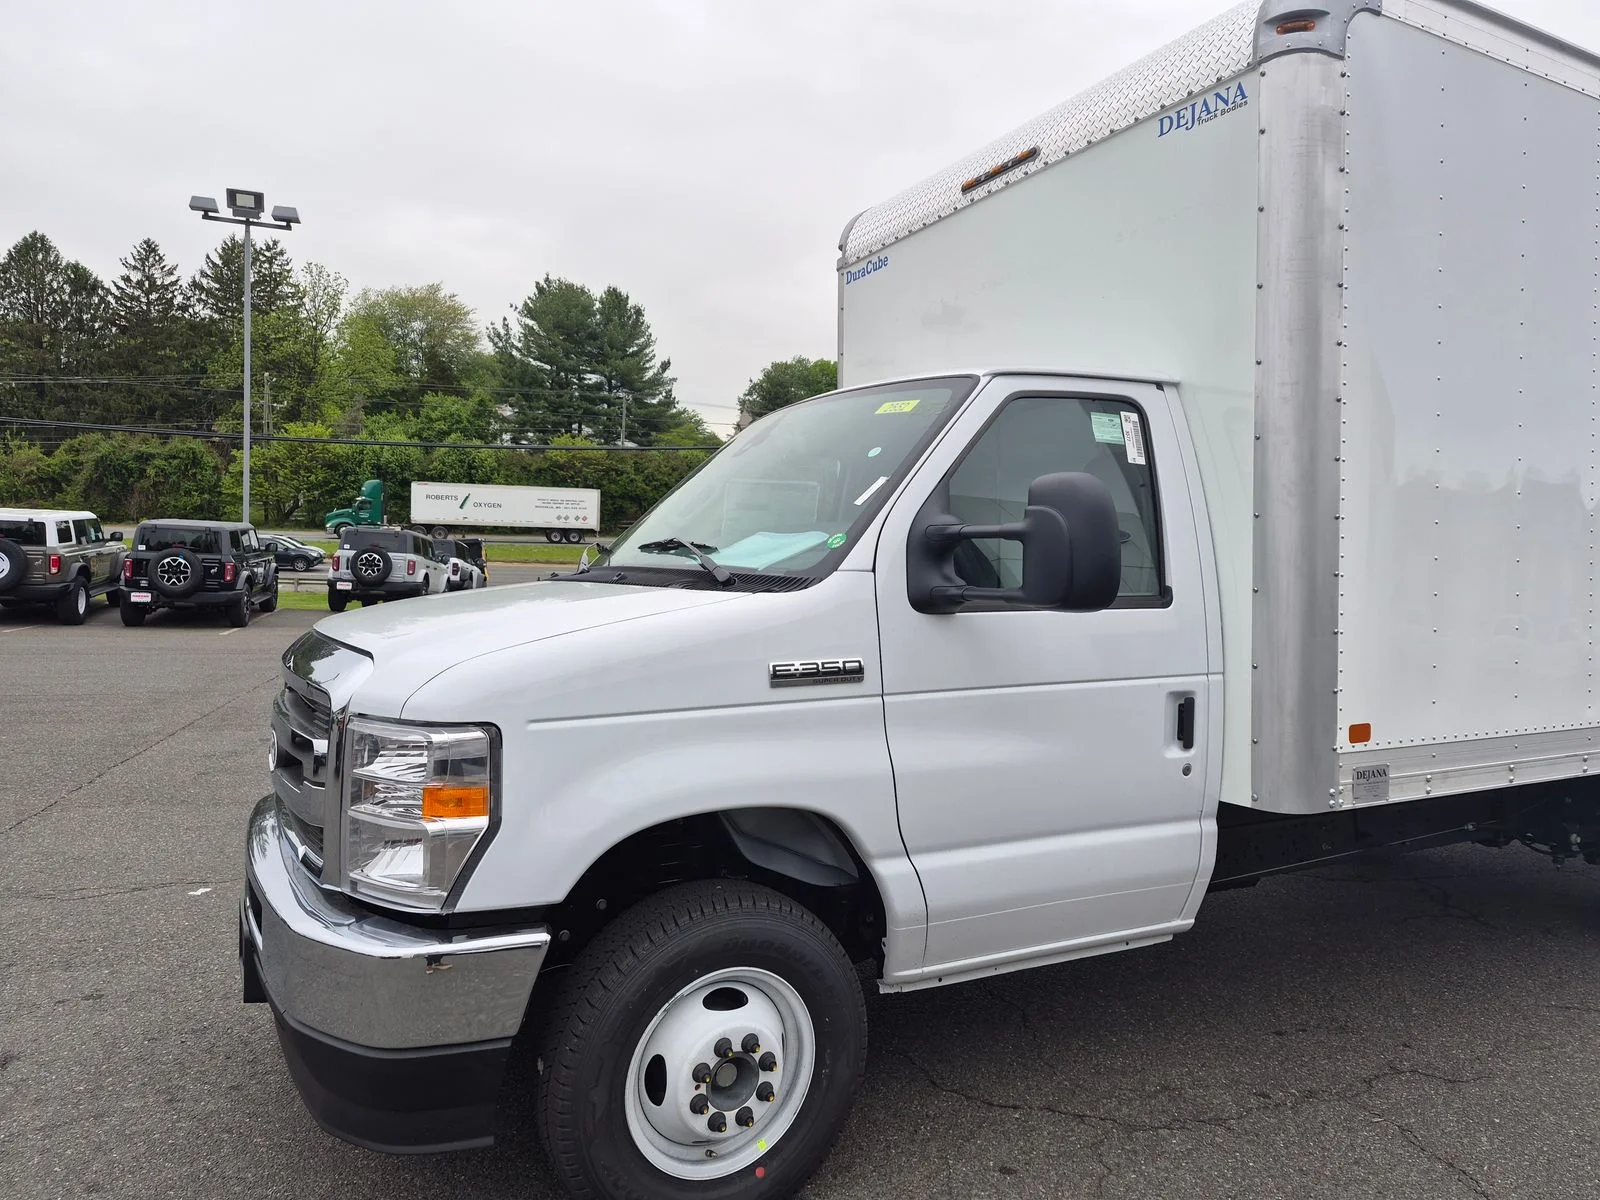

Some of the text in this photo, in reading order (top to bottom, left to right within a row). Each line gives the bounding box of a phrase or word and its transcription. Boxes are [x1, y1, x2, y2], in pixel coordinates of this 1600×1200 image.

[1158, 81, 1248, 138] DEJANA
[1197, 99, 1248, 126] Truck Bodies
[845, 255, 889, 285] DuraCube
[771, 659, 863, 679] E-350
[1356, 768, 1387, 781] DEJANA
